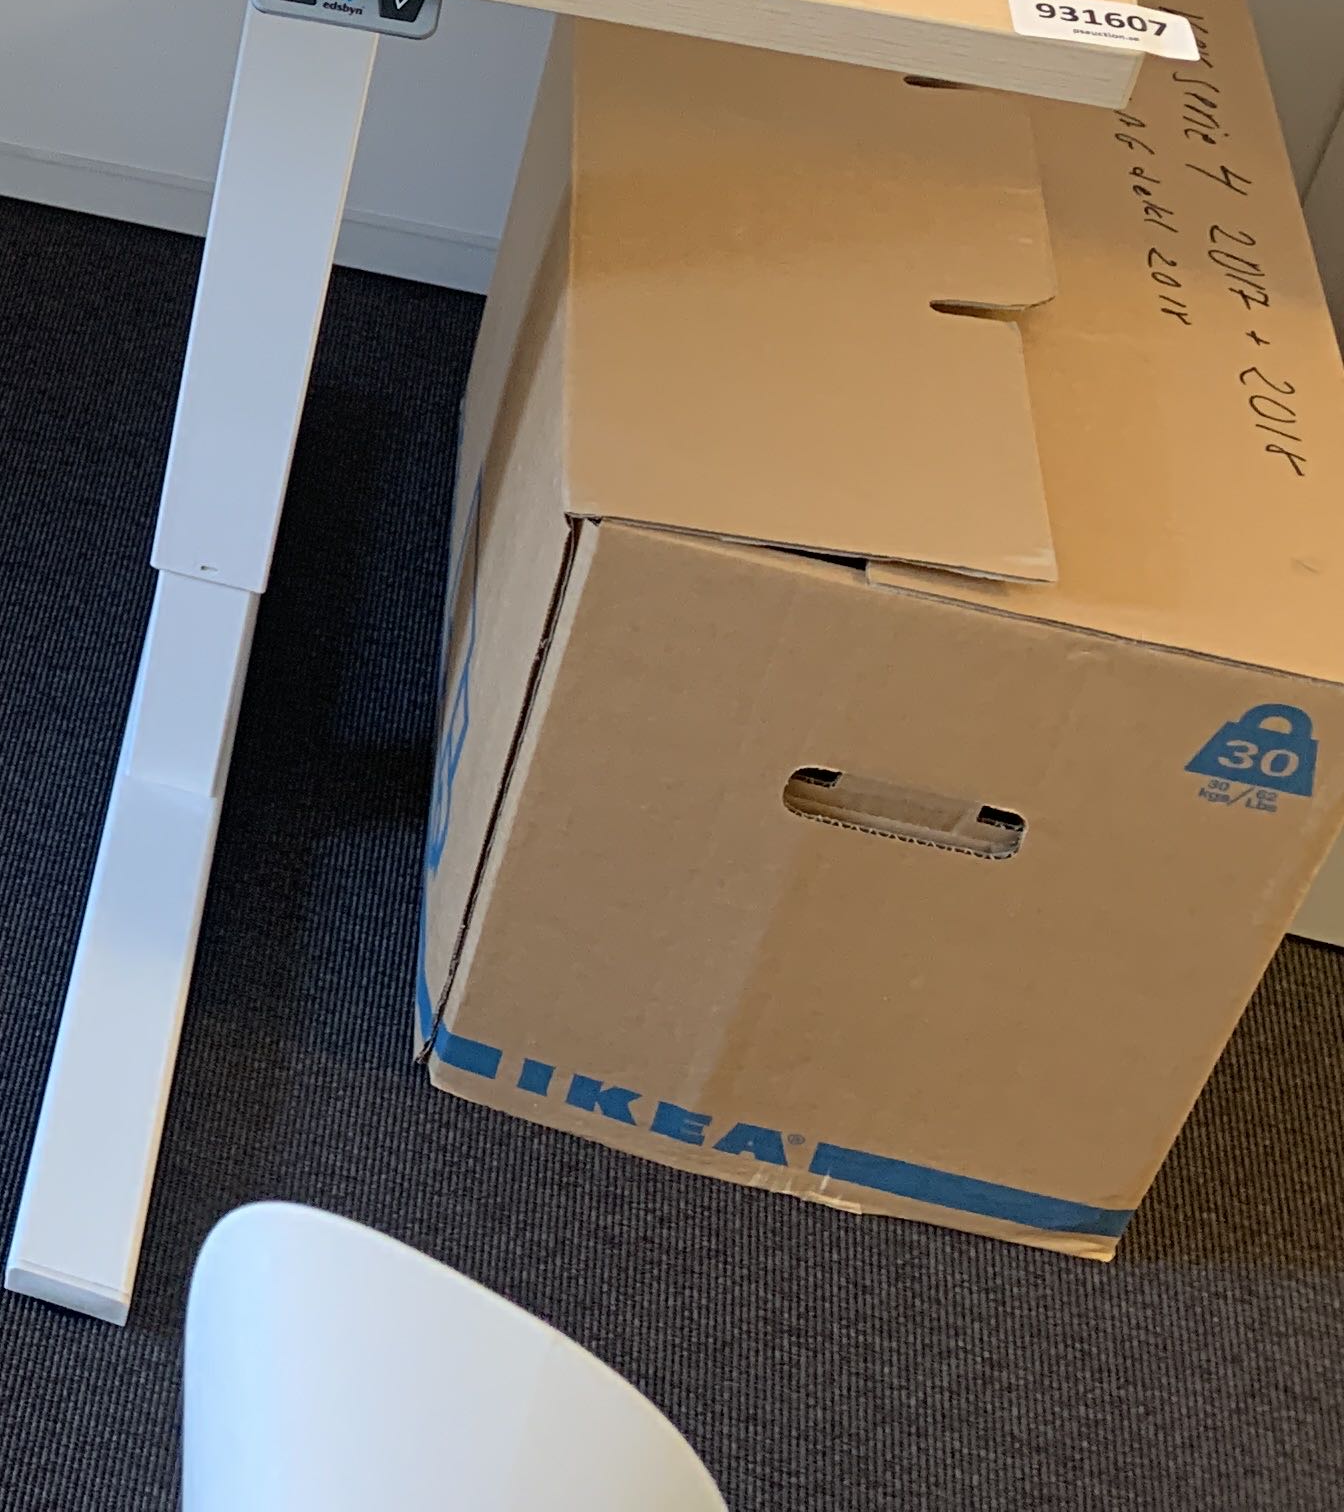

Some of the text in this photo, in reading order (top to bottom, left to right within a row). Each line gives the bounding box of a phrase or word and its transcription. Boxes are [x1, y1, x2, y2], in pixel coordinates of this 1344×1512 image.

[322, 1, 363, 16] edsbyn
[1035, 2, 1168, 37] 931607
[1185, 165, 1252, 196] 4
[1147, 247, 1192, 326] 2018
[1208, 224, 1270, 311] 2017
[1239, 366, 1307, 477] 2018
[1217, 739, 1300, 778] 30
[1208, 779, 1231, 792] 30
[516, 1057, 789, 1168] IKEA
